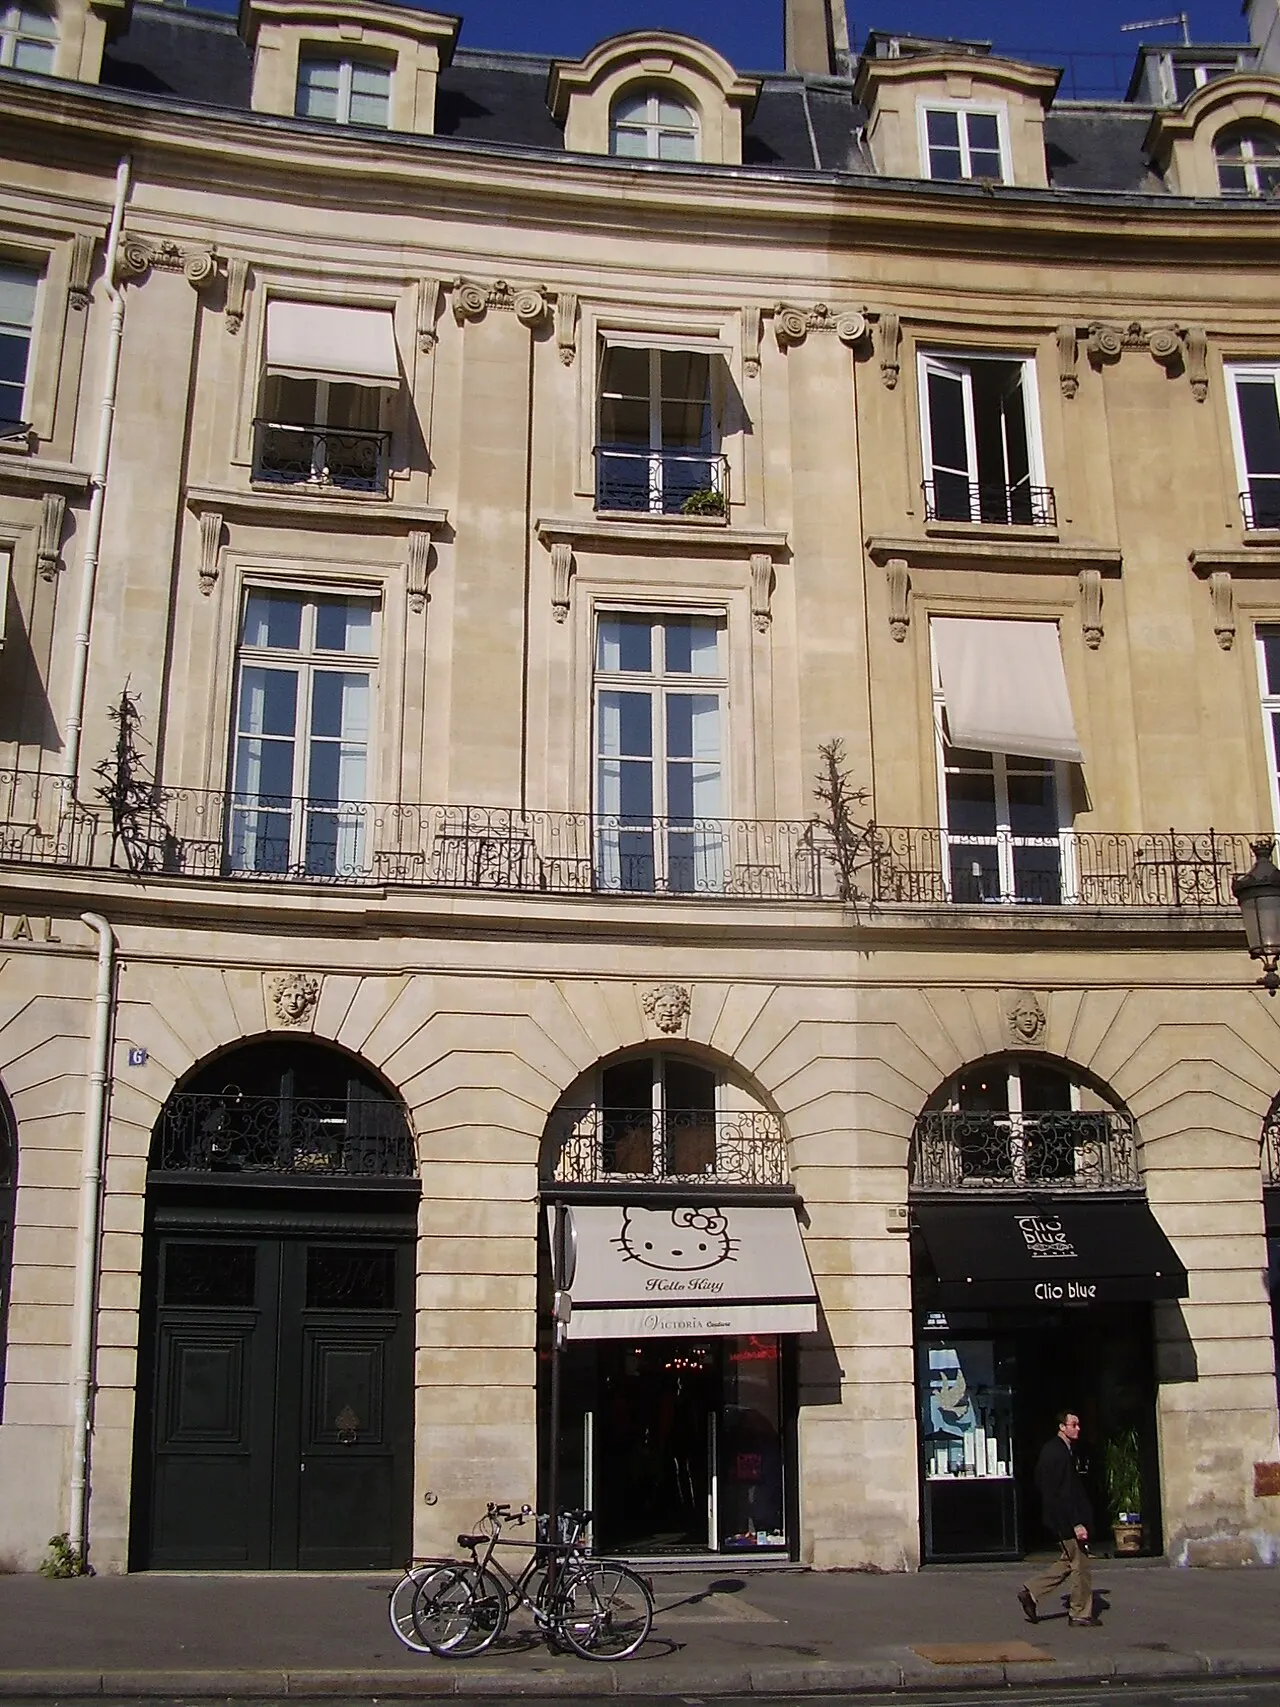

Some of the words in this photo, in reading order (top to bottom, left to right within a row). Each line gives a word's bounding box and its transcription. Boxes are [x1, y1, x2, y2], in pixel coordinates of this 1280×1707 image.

[133, 1050, 143, 1064] 6
[1019, 1218, 1062, 1232] Clio
[1023, 1230, 1067, 1243] blue
[645, 1278, 685, 1291] Hello
[687, 1278, 724, 1293] Kitty
[1035, 1283, 1063, 1299] Clio
[1068, 1282, 1097, 1298] blue
